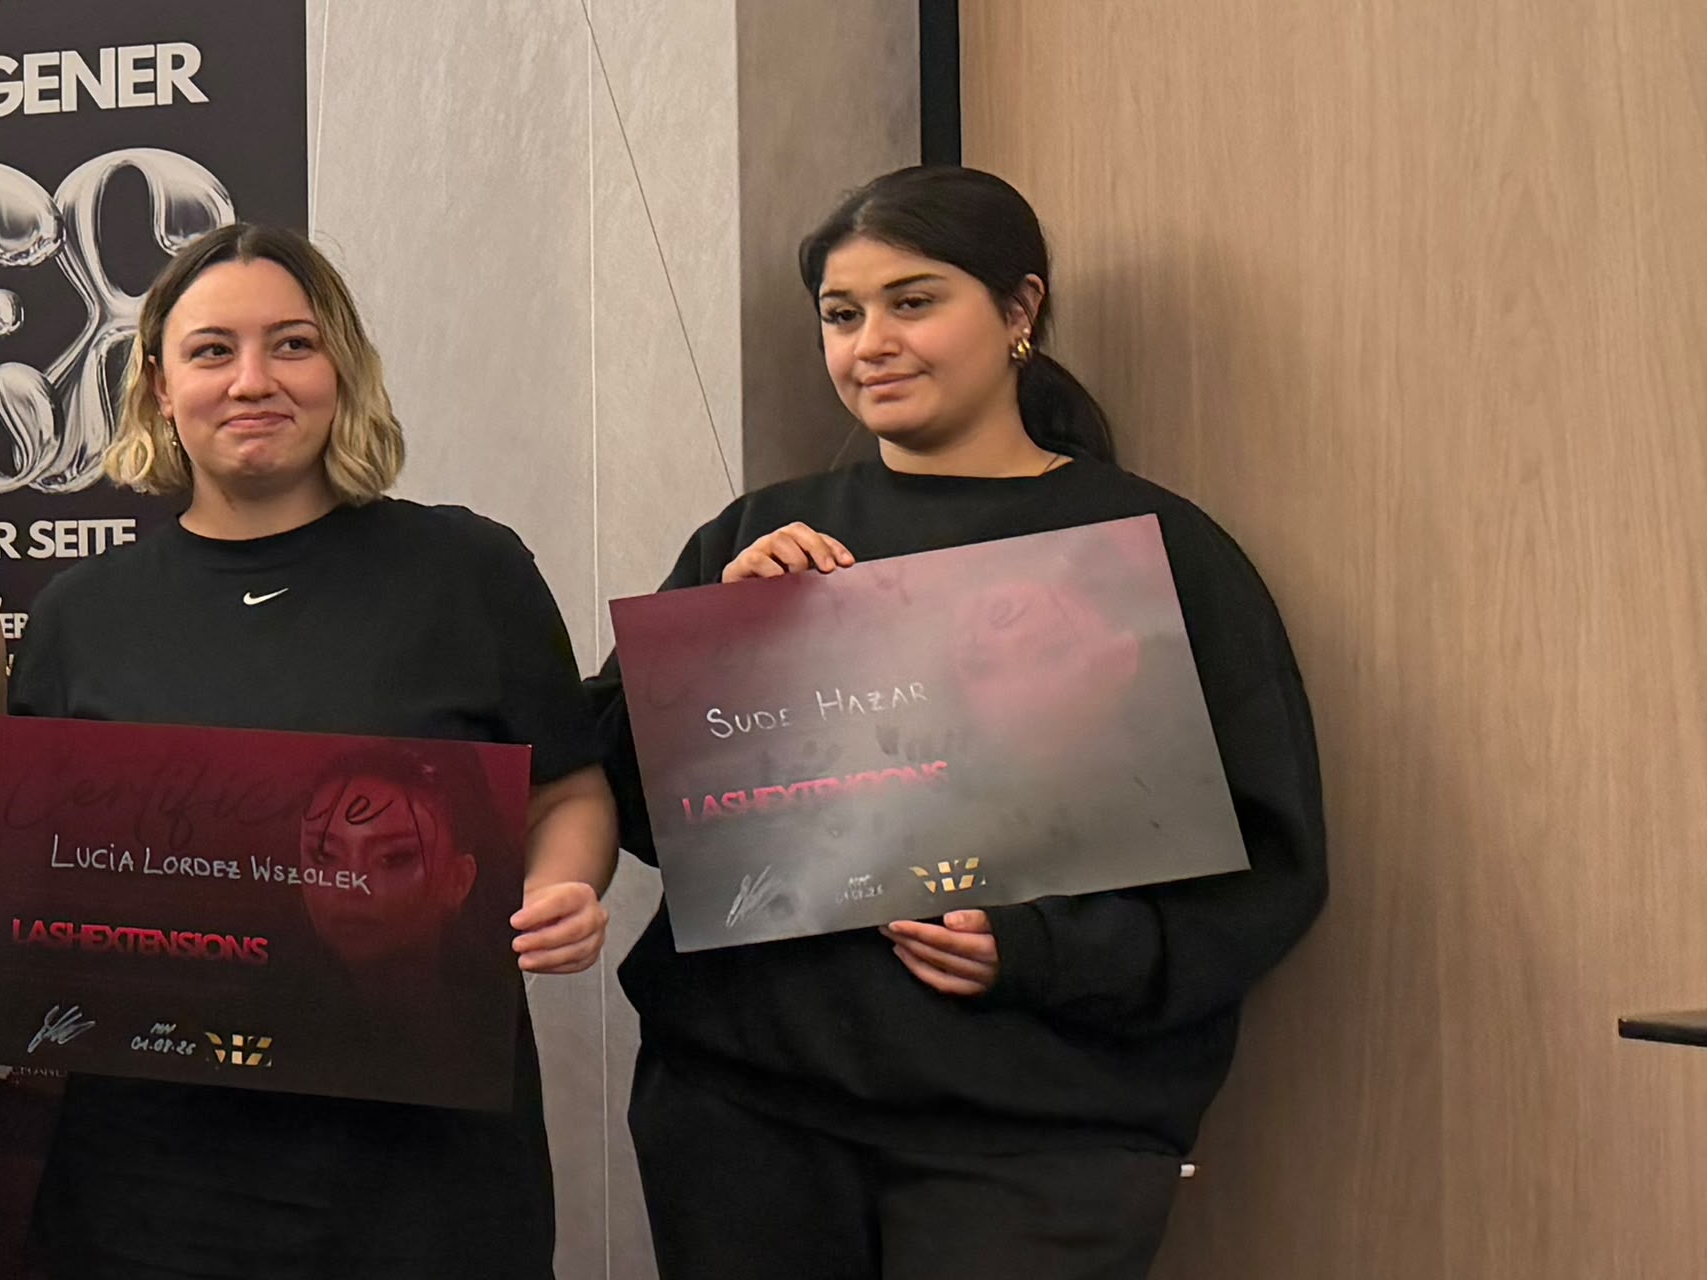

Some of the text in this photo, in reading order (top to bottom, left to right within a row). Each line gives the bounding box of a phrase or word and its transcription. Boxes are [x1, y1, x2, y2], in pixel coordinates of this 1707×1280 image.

[815, 681, 929, 720] HAZAR
[144, 847, 242, 879] LORDEZ
[251, 856, 371, 895] WSZOLEK
[12, 918, 270, 966] LASHEXTENSIONS
